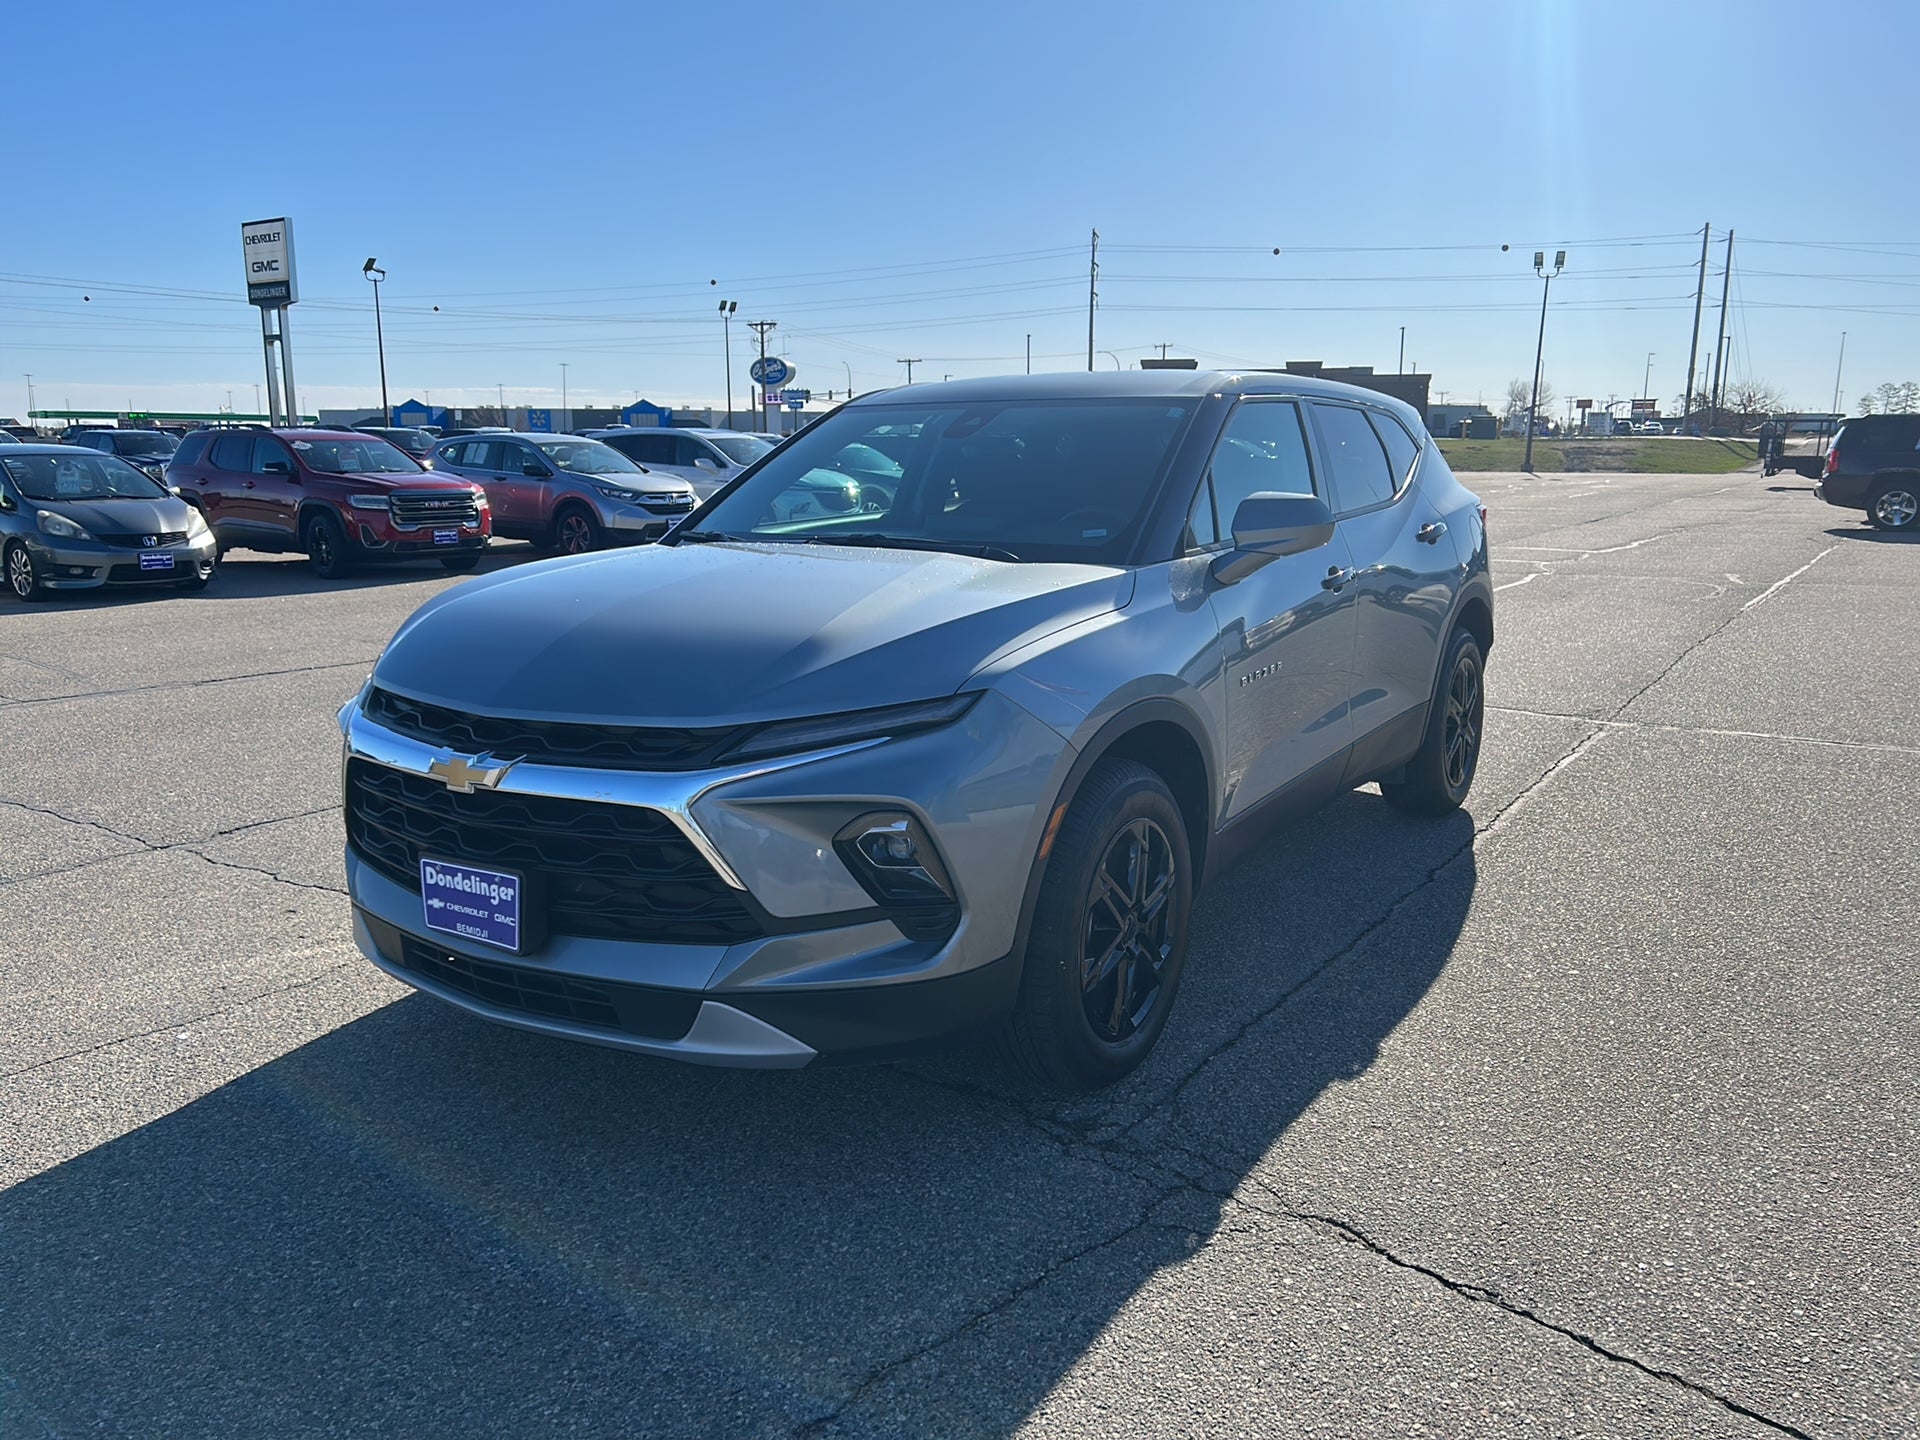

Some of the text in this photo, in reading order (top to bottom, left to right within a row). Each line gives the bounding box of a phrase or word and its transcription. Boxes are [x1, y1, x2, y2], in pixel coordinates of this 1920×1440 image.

[245, 232, 281, 245] CHEVROLET
[251, 259, 279, 273] GMC
[1240, 661, 1282, 687] BLAZER
[425, 866, 515, 906] Dondelinger
[446, 902, 516, 927] CHEVROLET GMC
[456, 922, 489, 939] BEMIDJI
